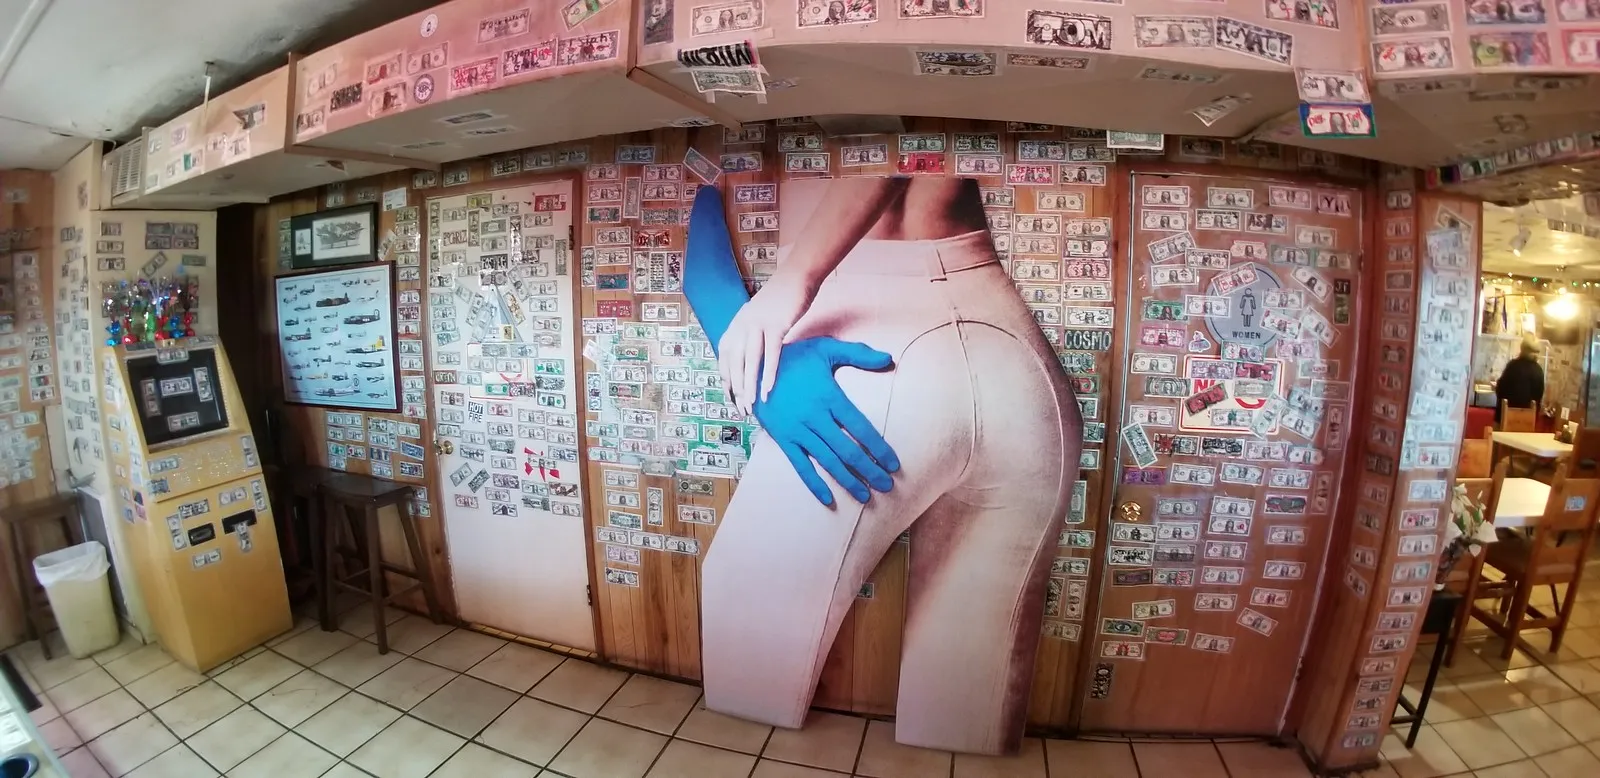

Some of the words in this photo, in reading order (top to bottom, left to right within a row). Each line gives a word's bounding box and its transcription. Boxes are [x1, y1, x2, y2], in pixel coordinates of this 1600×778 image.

[1033, 14, 1111, 49] TOM
[1064, 329, 1113, 352] COSMO
[1232, 331, 1261, 339] WOMEN
[469, 402, 484, 414] HOT
[468, 412, 483, 423] FIRE
